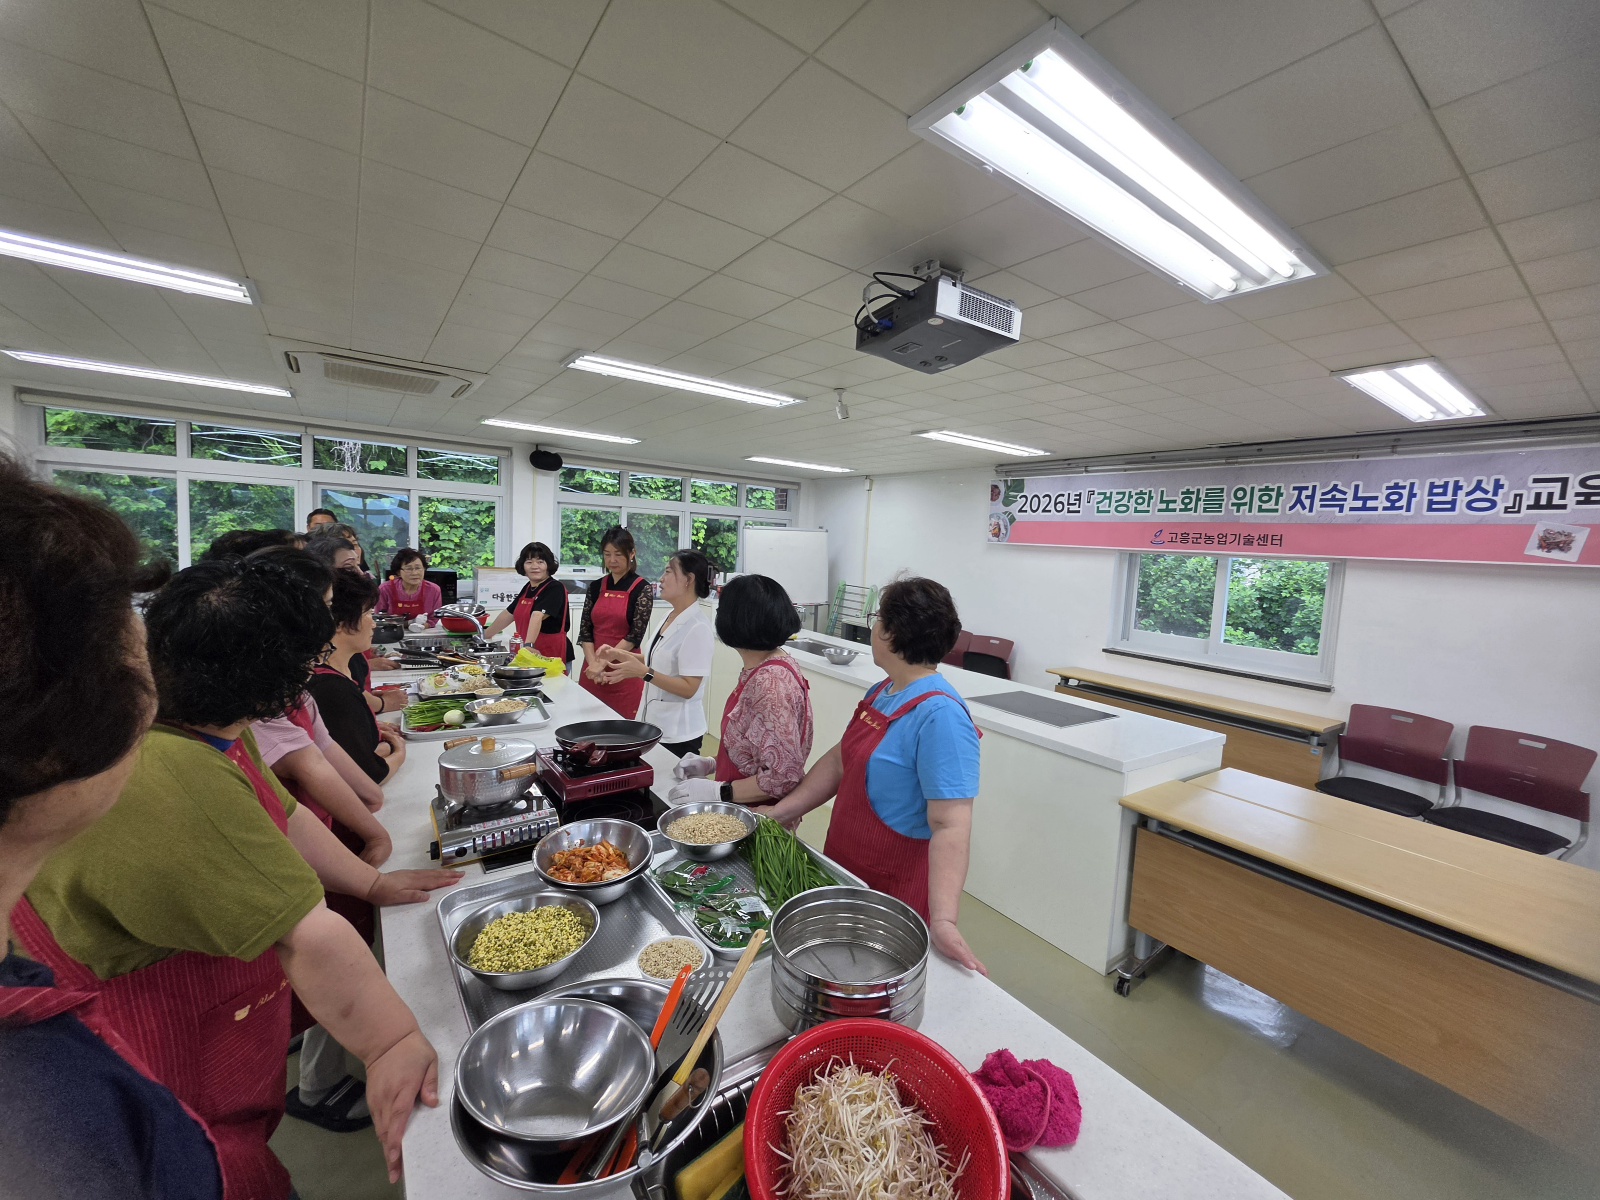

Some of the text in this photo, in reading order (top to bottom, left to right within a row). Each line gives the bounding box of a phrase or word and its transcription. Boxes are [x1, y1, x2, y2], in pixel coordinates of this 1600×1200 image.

[1017, 492, 1082, 514] 2026년
[1086, 490, 1154, 514] 『건강한
[1157, 487, 1225, 514] 노화를
[1230, 485, 1284, 514] 위한
[1288, 482, 1418, 514] 저속노화
[1166, 531, 1284, 548] 고흥군농업기술센터
